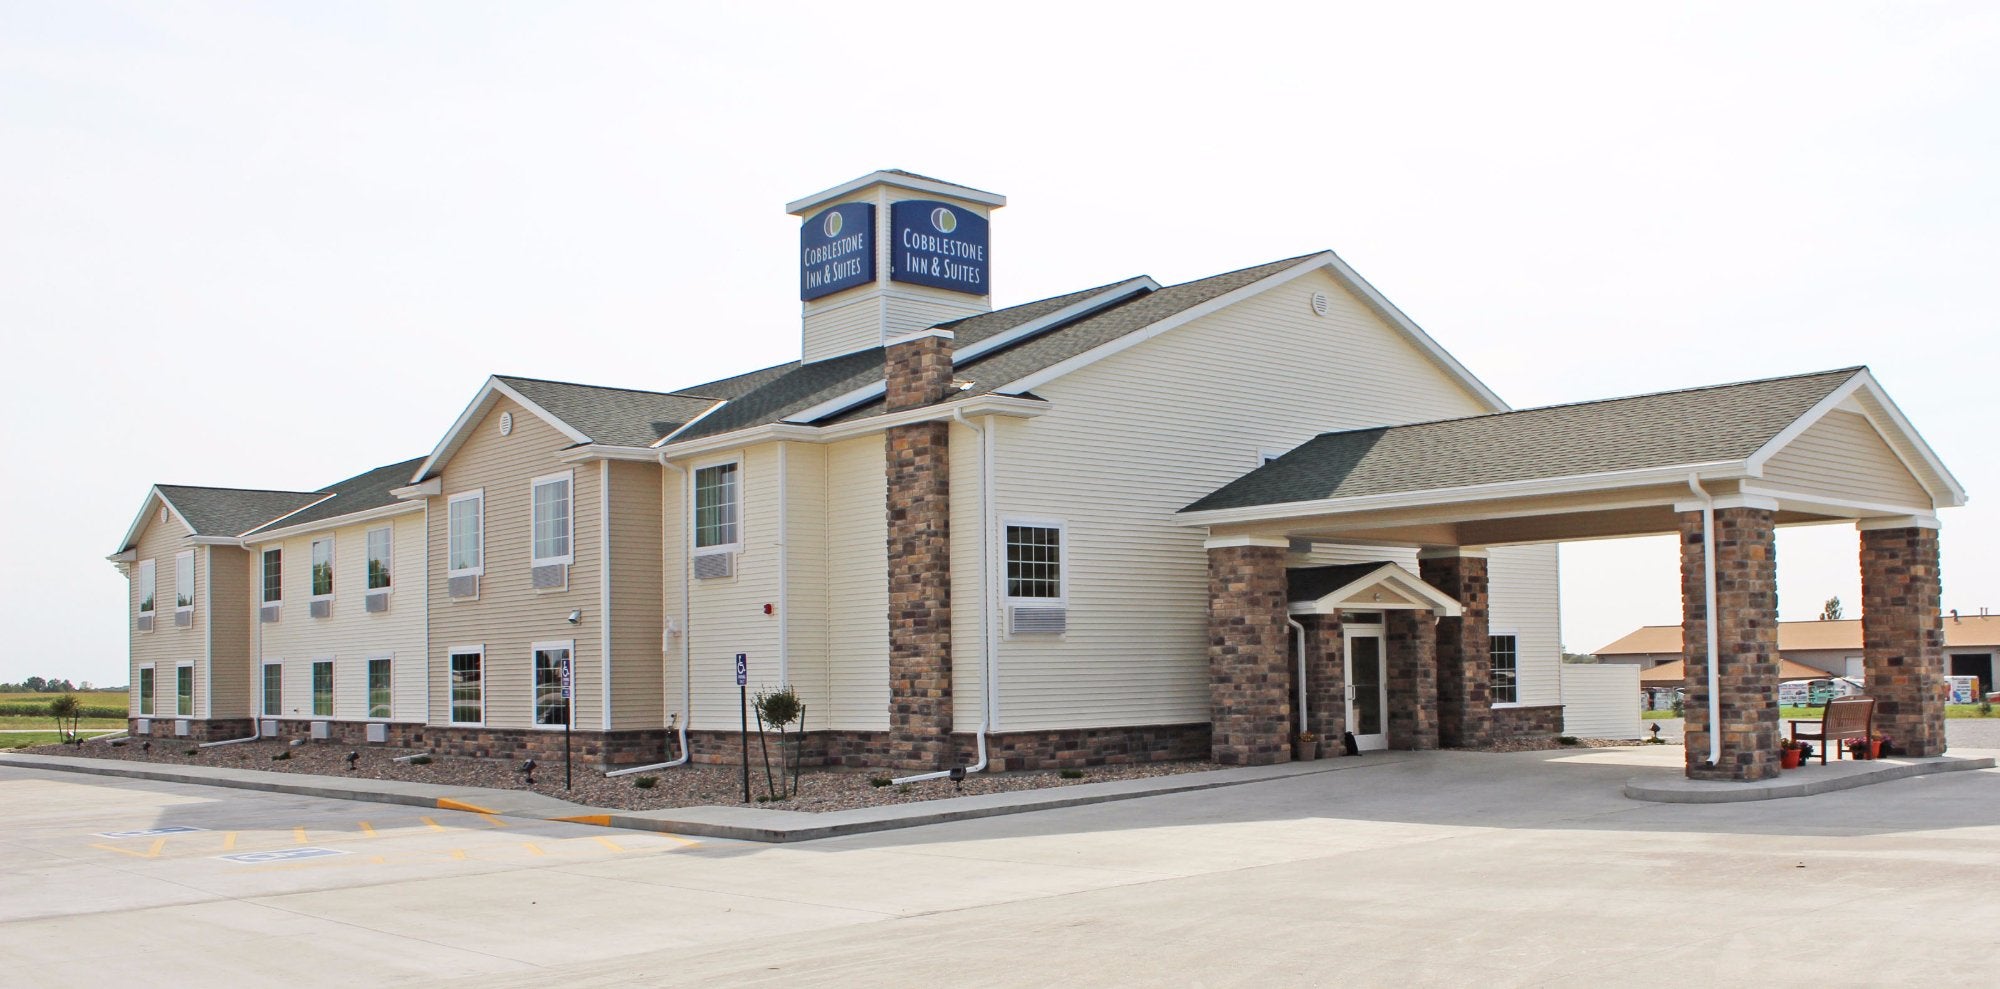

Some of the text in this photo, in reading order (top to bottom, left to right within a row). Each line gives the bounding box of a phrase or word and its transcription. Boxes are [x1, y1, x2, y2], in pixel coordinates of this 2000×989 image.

[804, 233, 863, 267] COBBLESTONE
[903, 227, 983, 262] COBBLESTONE
[806, 257, 861, 290] INN & SUITES
[906, 252, 980, 284] INN & SUITES
